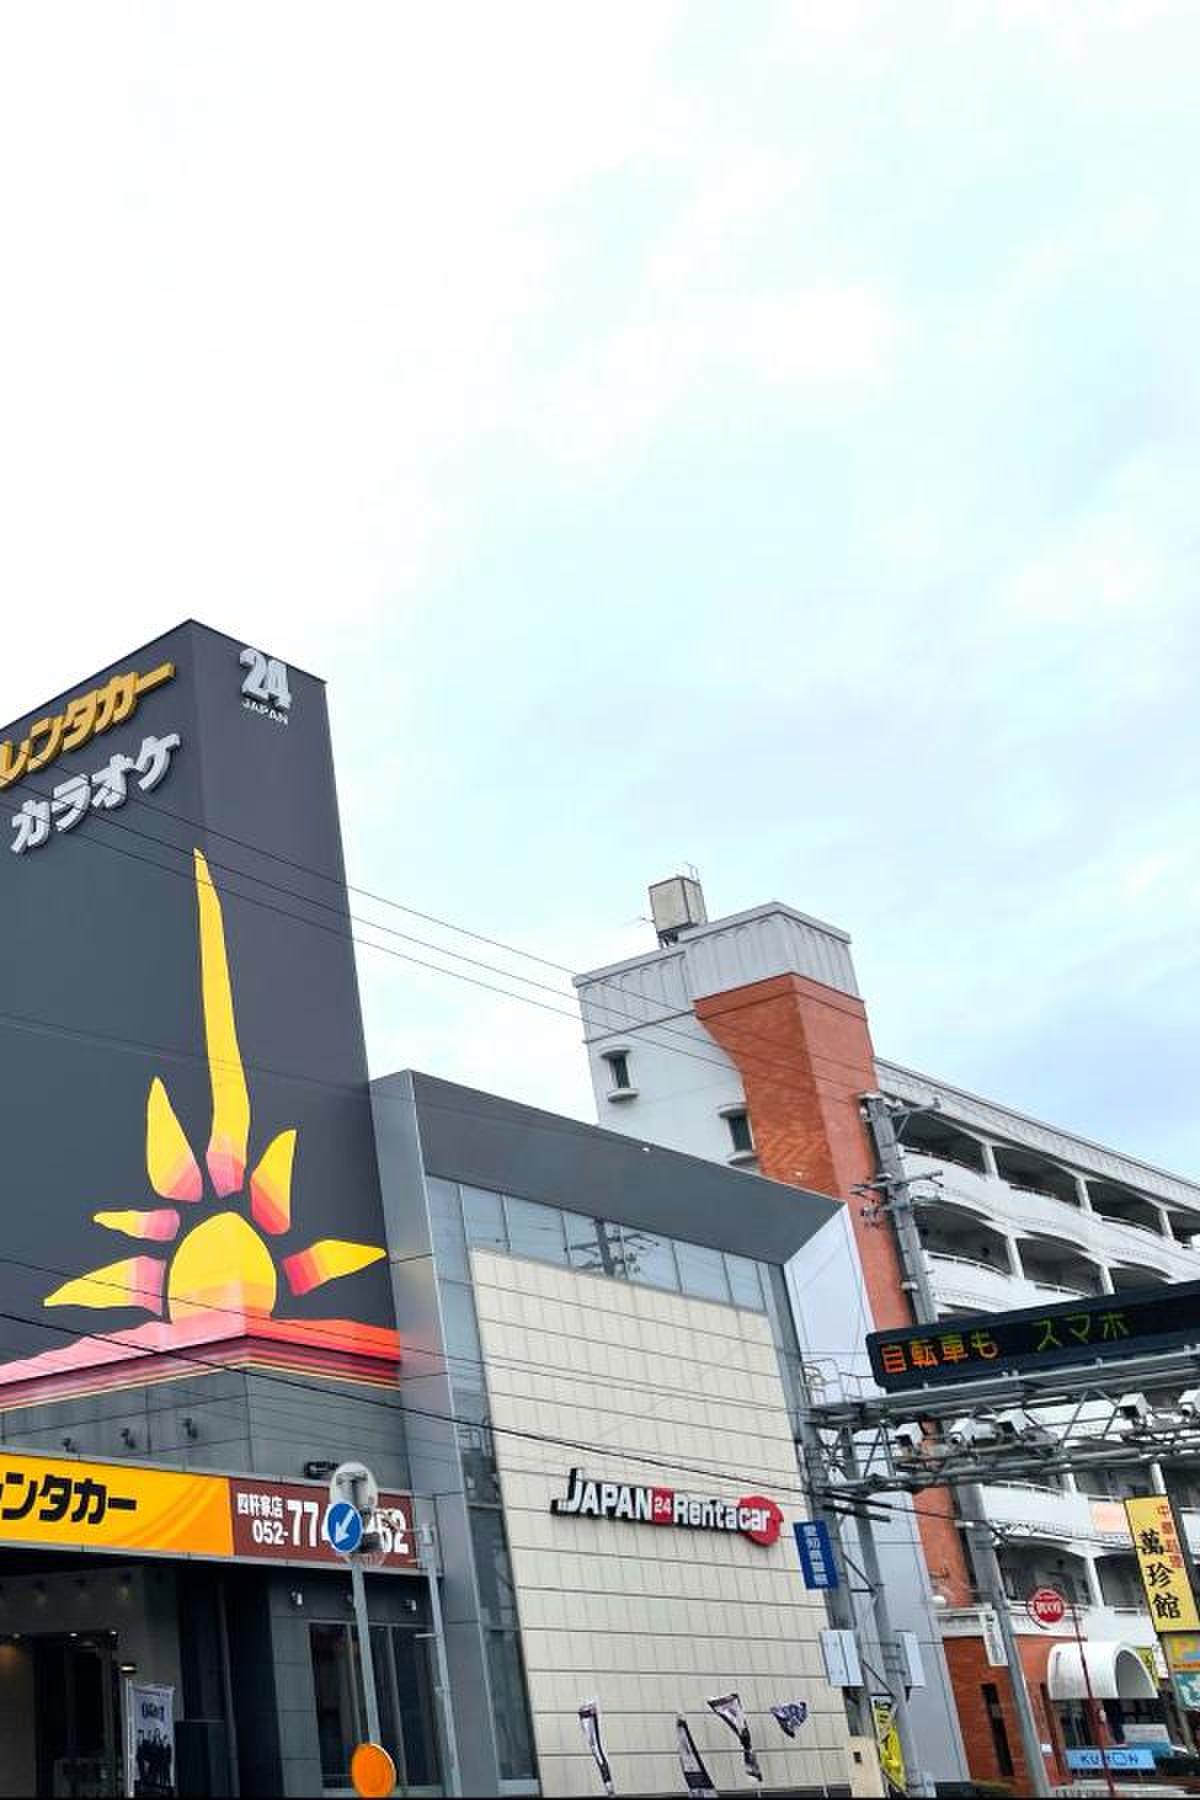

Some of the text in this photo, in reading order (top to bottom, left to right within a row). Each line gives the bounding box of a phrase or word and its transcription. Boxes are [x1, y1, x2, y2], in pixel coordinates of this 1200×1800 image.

[239, 648, 291, 709] 24
[241, 698, 288, 725] JAPAN
[10, 733, 181, 853] カラオケ
[881, 1312, 1131, 1374] 自転車も スマホ
[553, 1468, 653, 1522] JAPAN
[1081, 1751, 1139, 1766] KUON
